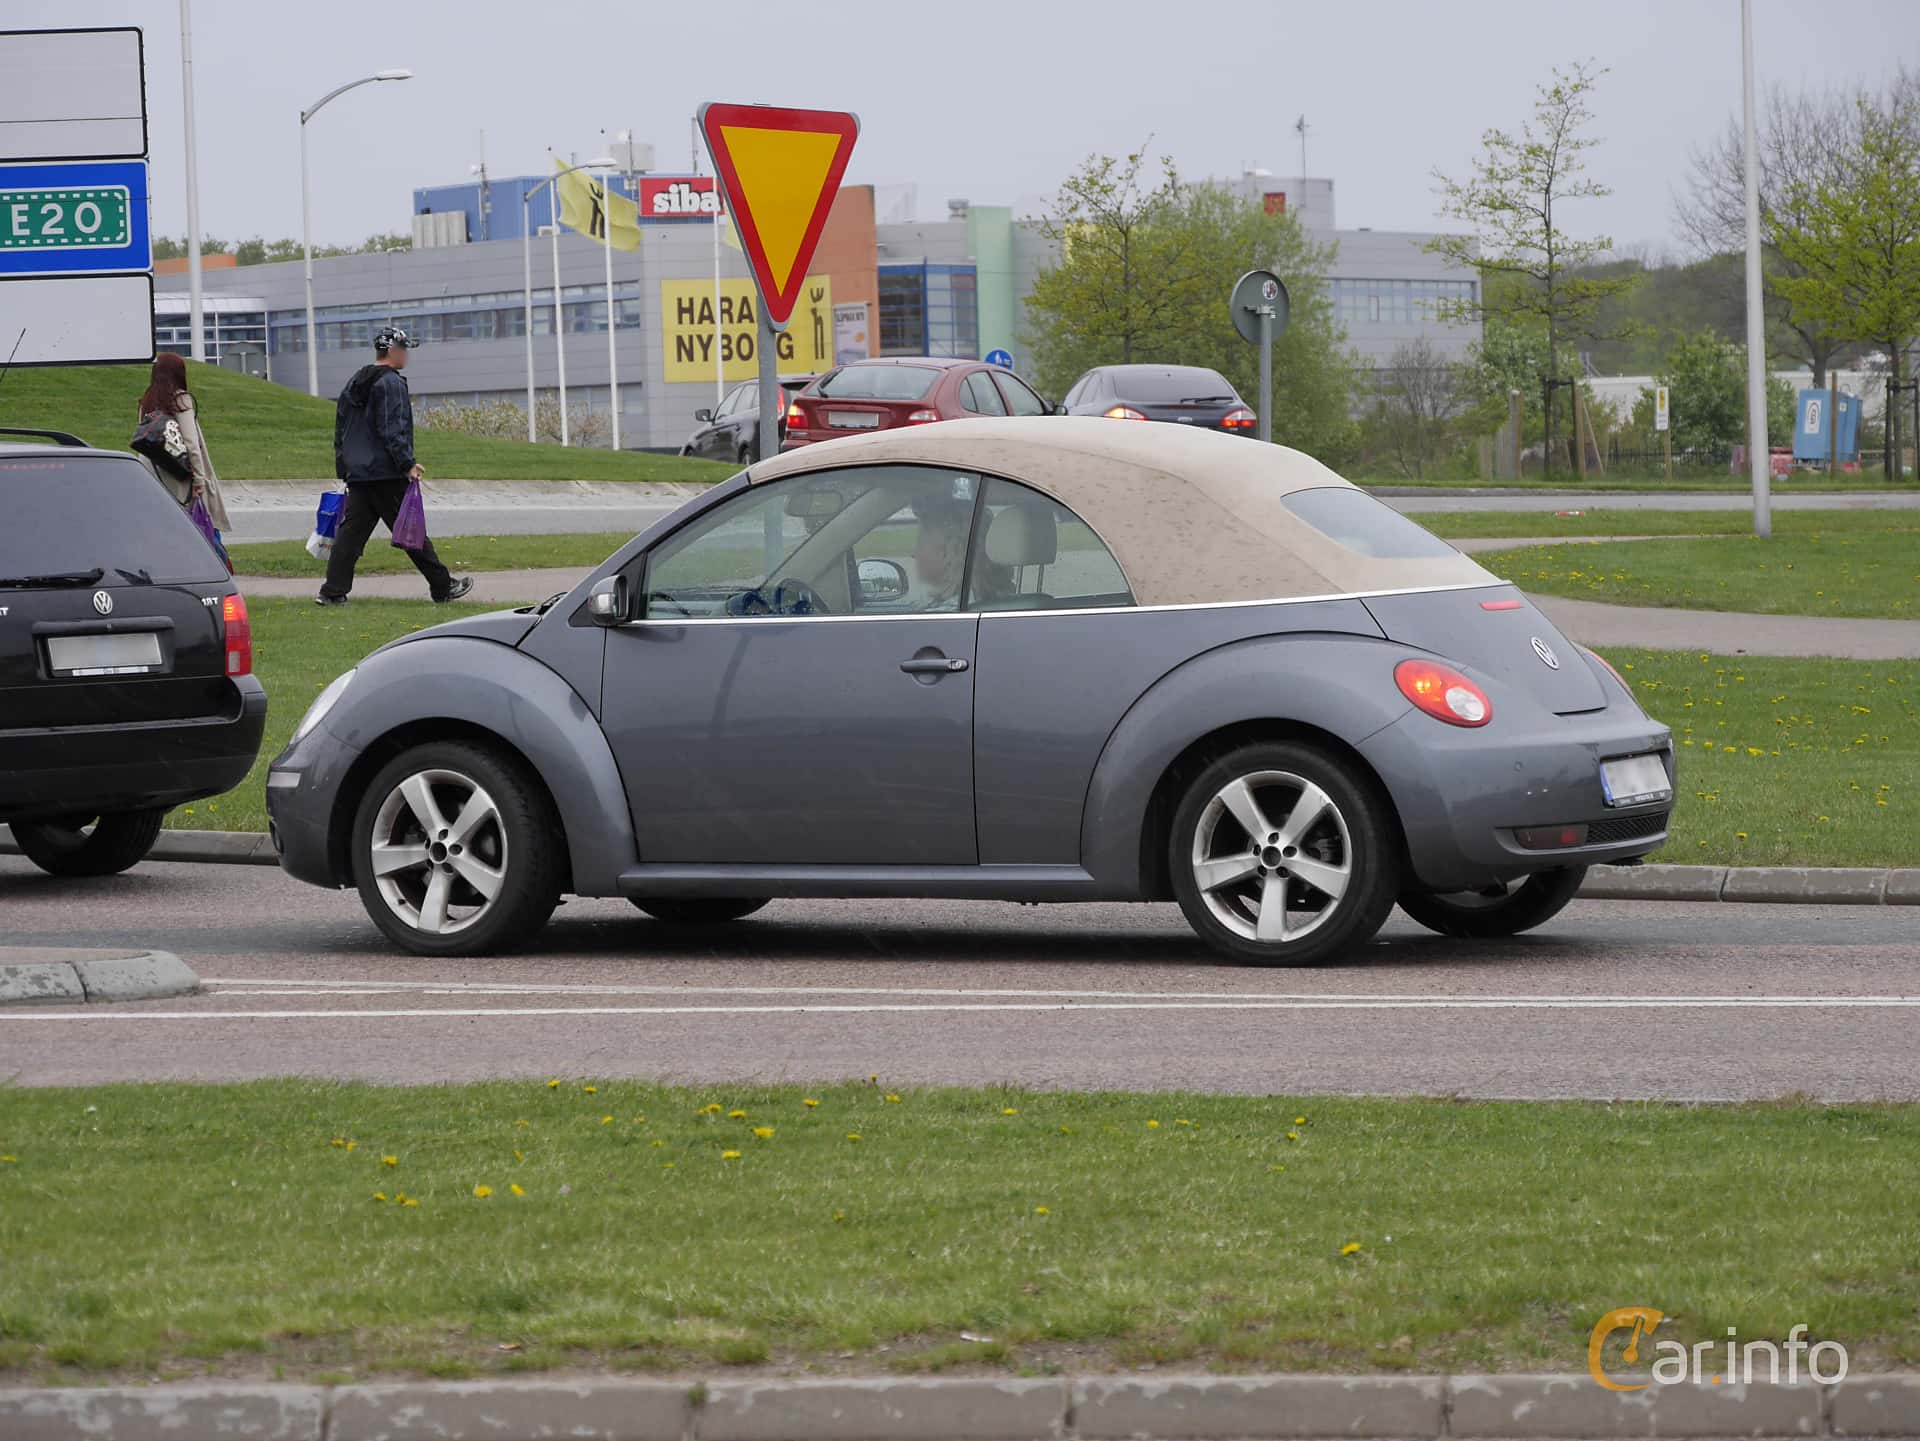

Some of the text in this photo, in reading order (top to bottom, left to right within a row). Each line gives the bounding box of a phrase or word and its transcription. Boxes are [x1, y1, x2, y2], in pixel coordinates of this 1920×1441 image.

[653, 183, 721, 213] siba
[11, 201, 102, 236] E20
[677, 296, 756, 325] HARA
[675, 332, 794, 362] NYBOG
